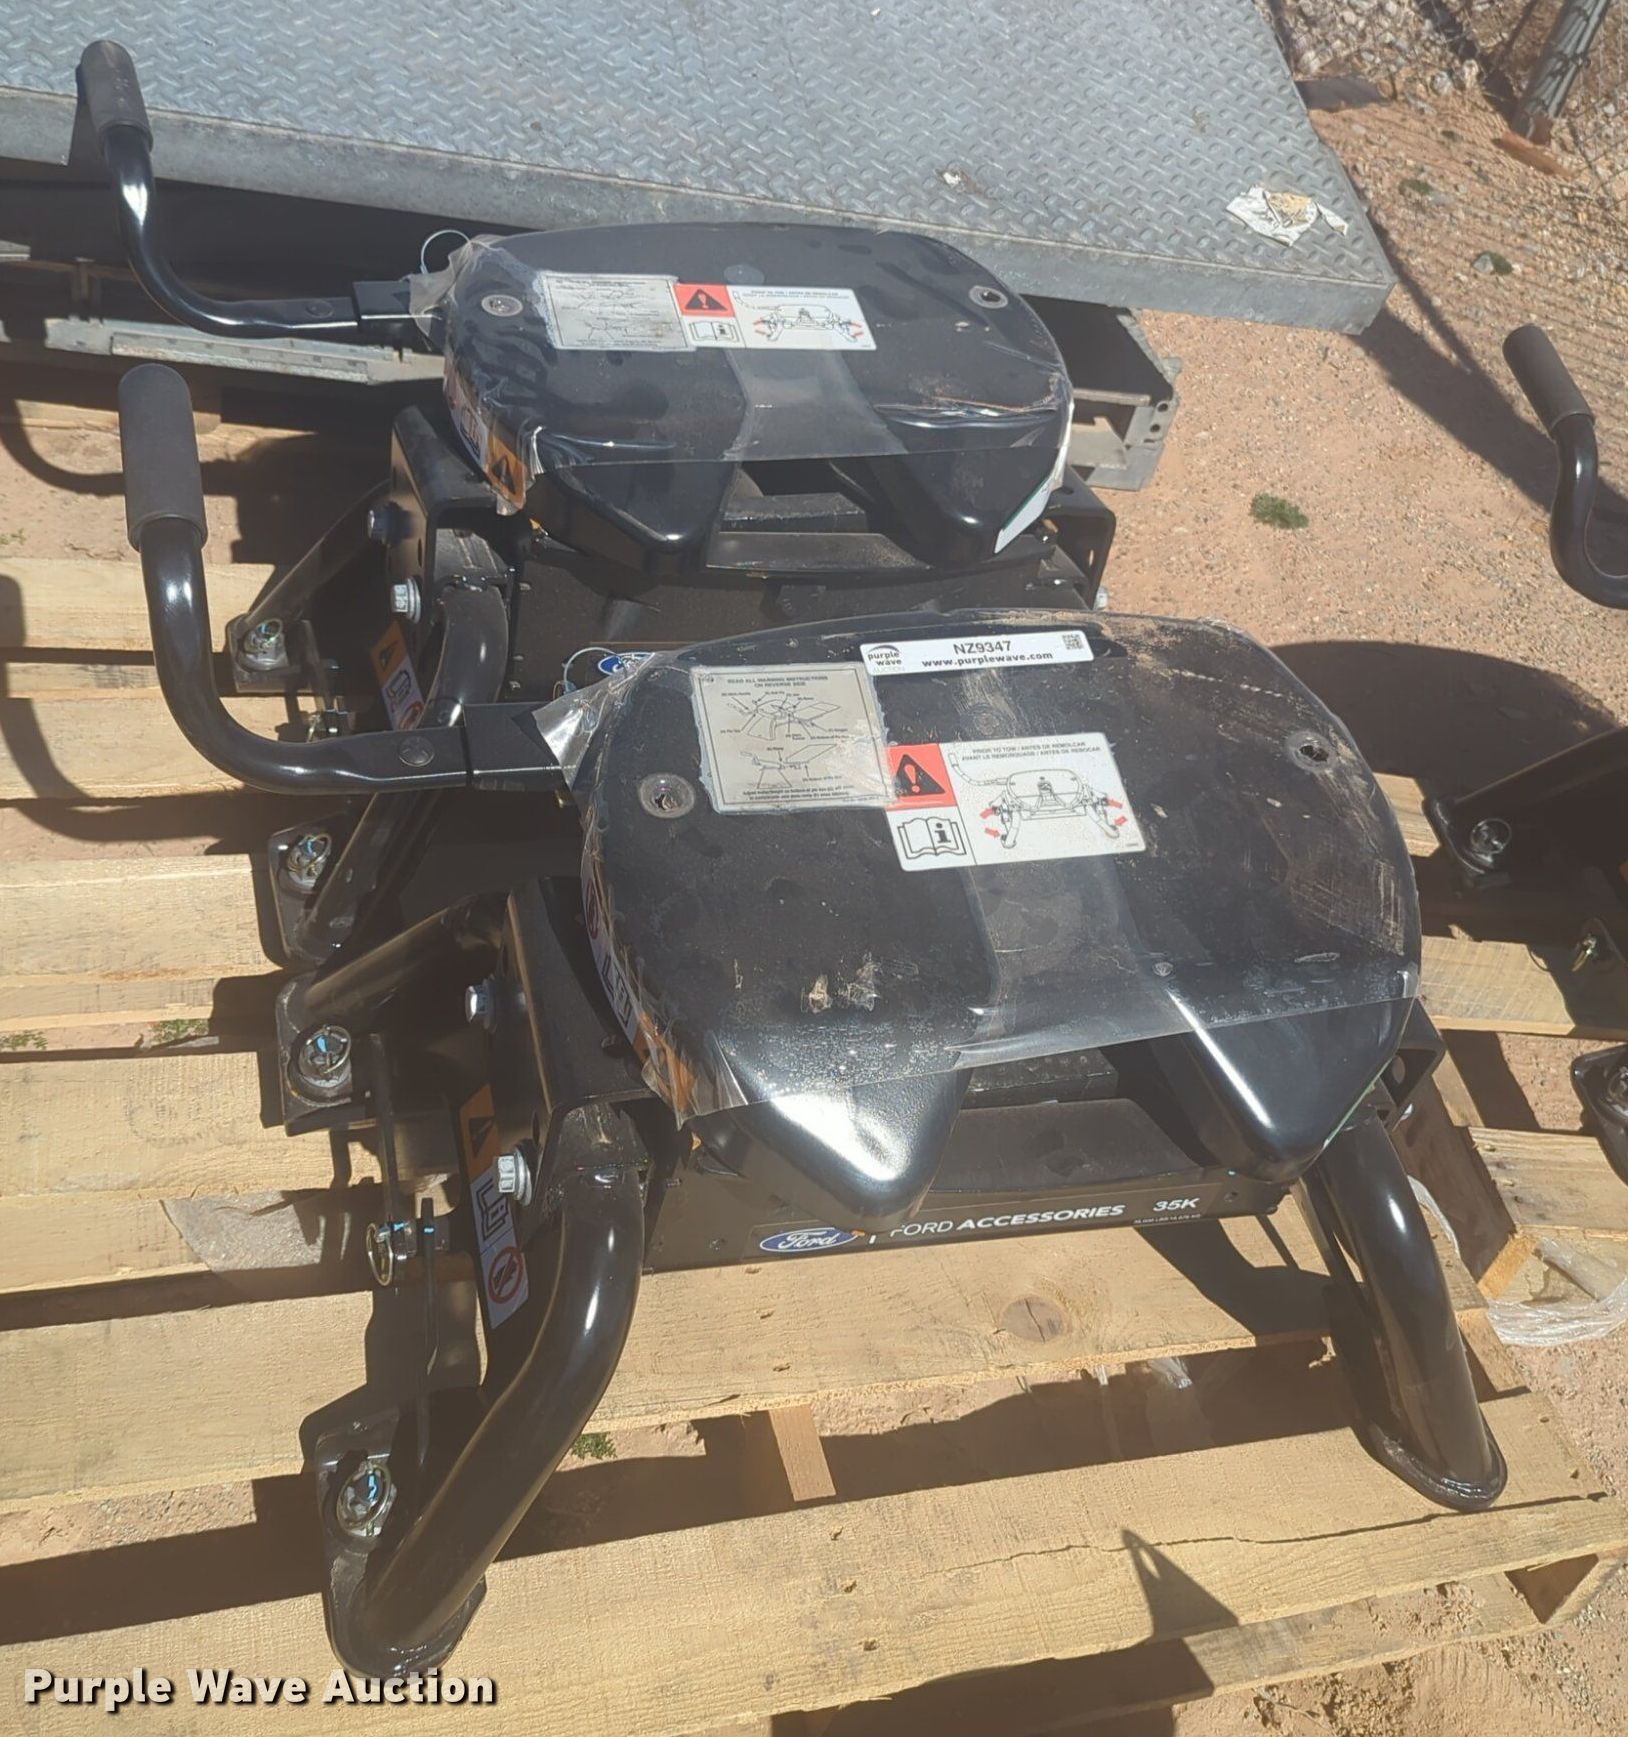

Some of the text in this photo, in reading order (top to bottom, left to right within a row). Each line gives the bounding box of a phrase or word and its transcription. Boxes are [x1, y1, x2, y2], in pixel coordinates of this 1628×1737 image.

[953, 640, 1011, 655] NZ9347
[867, 651, 900, 661] purple
[922, 652, 1054, 667] www.purplewave.com
[1153, 1198, 1200, 1212] 35K
[956, 1204, 1126, 1231] ACCESSORIES
[778, 1230, 840, 1249] Ford
